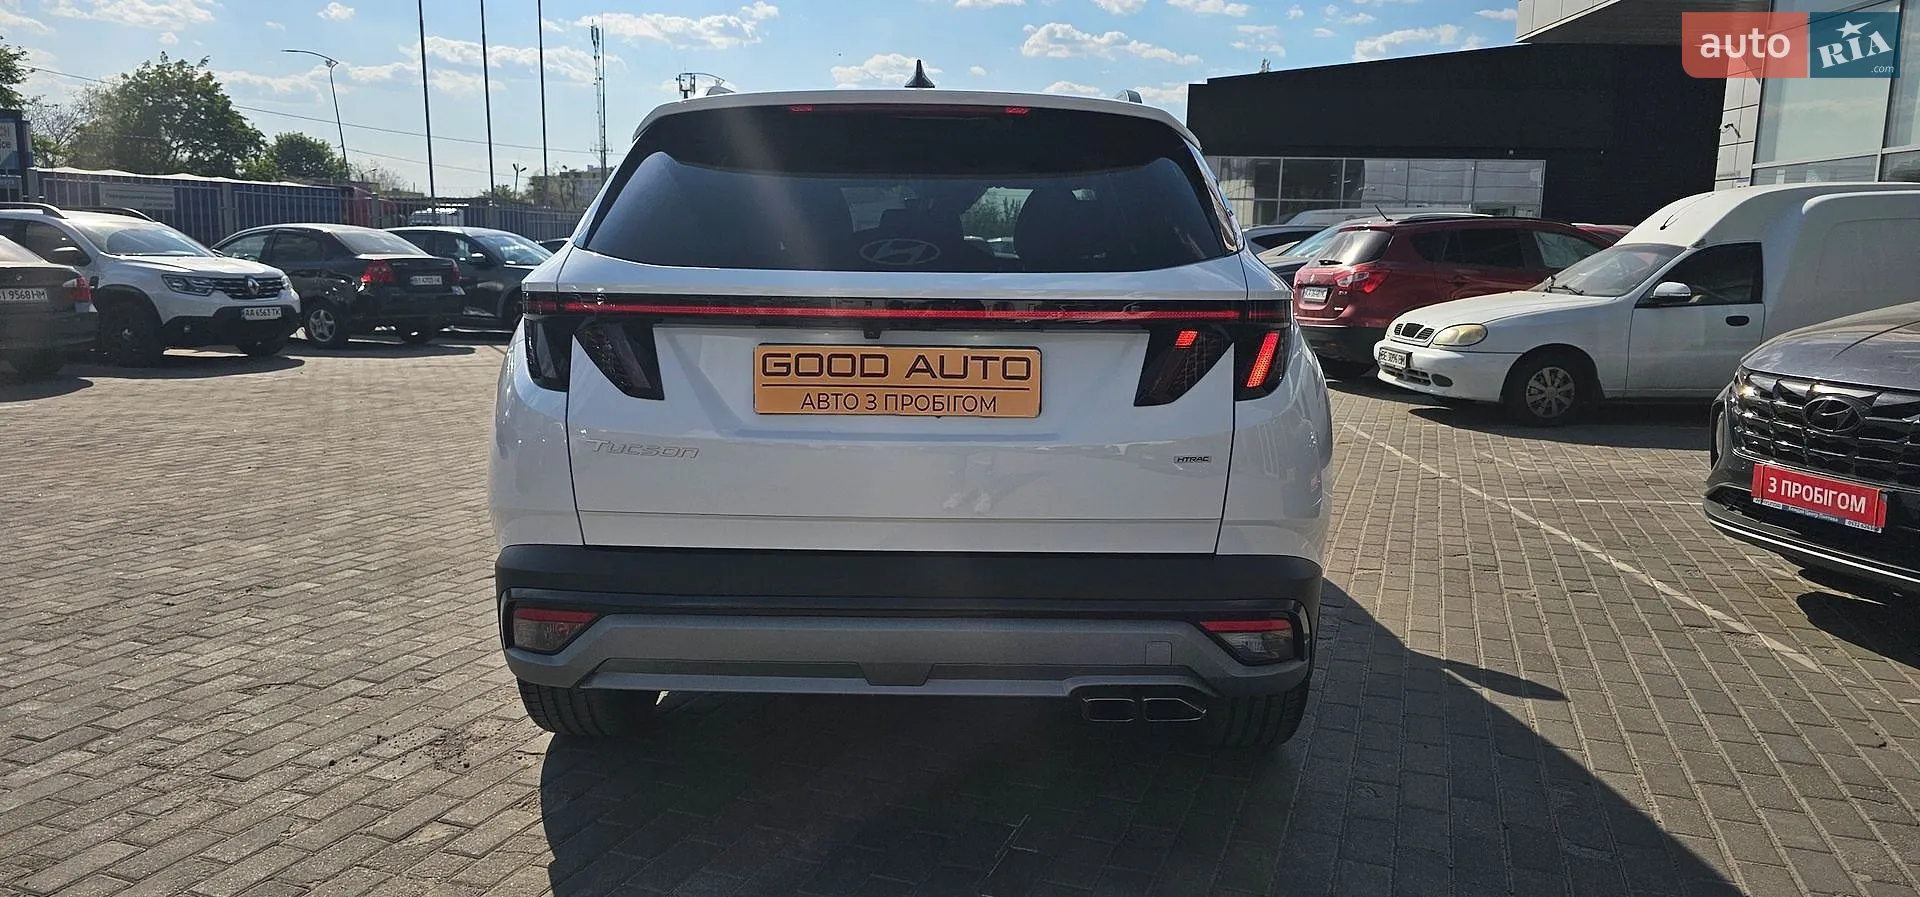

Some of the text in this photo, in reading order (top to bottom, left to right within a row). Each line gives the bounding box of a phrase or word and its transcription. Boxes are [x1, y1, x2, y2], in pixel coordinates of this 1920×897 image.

[9, 290, 31, 300] 9568
[761, 352, 1032, 381] GOOD AUTO
[800, 392, 997, 413] АВТО З ПРОБІГОМ
[1767, 476, 1777, 494] З
[1780, 479, 1867, 514] ПРОБІГОМ
